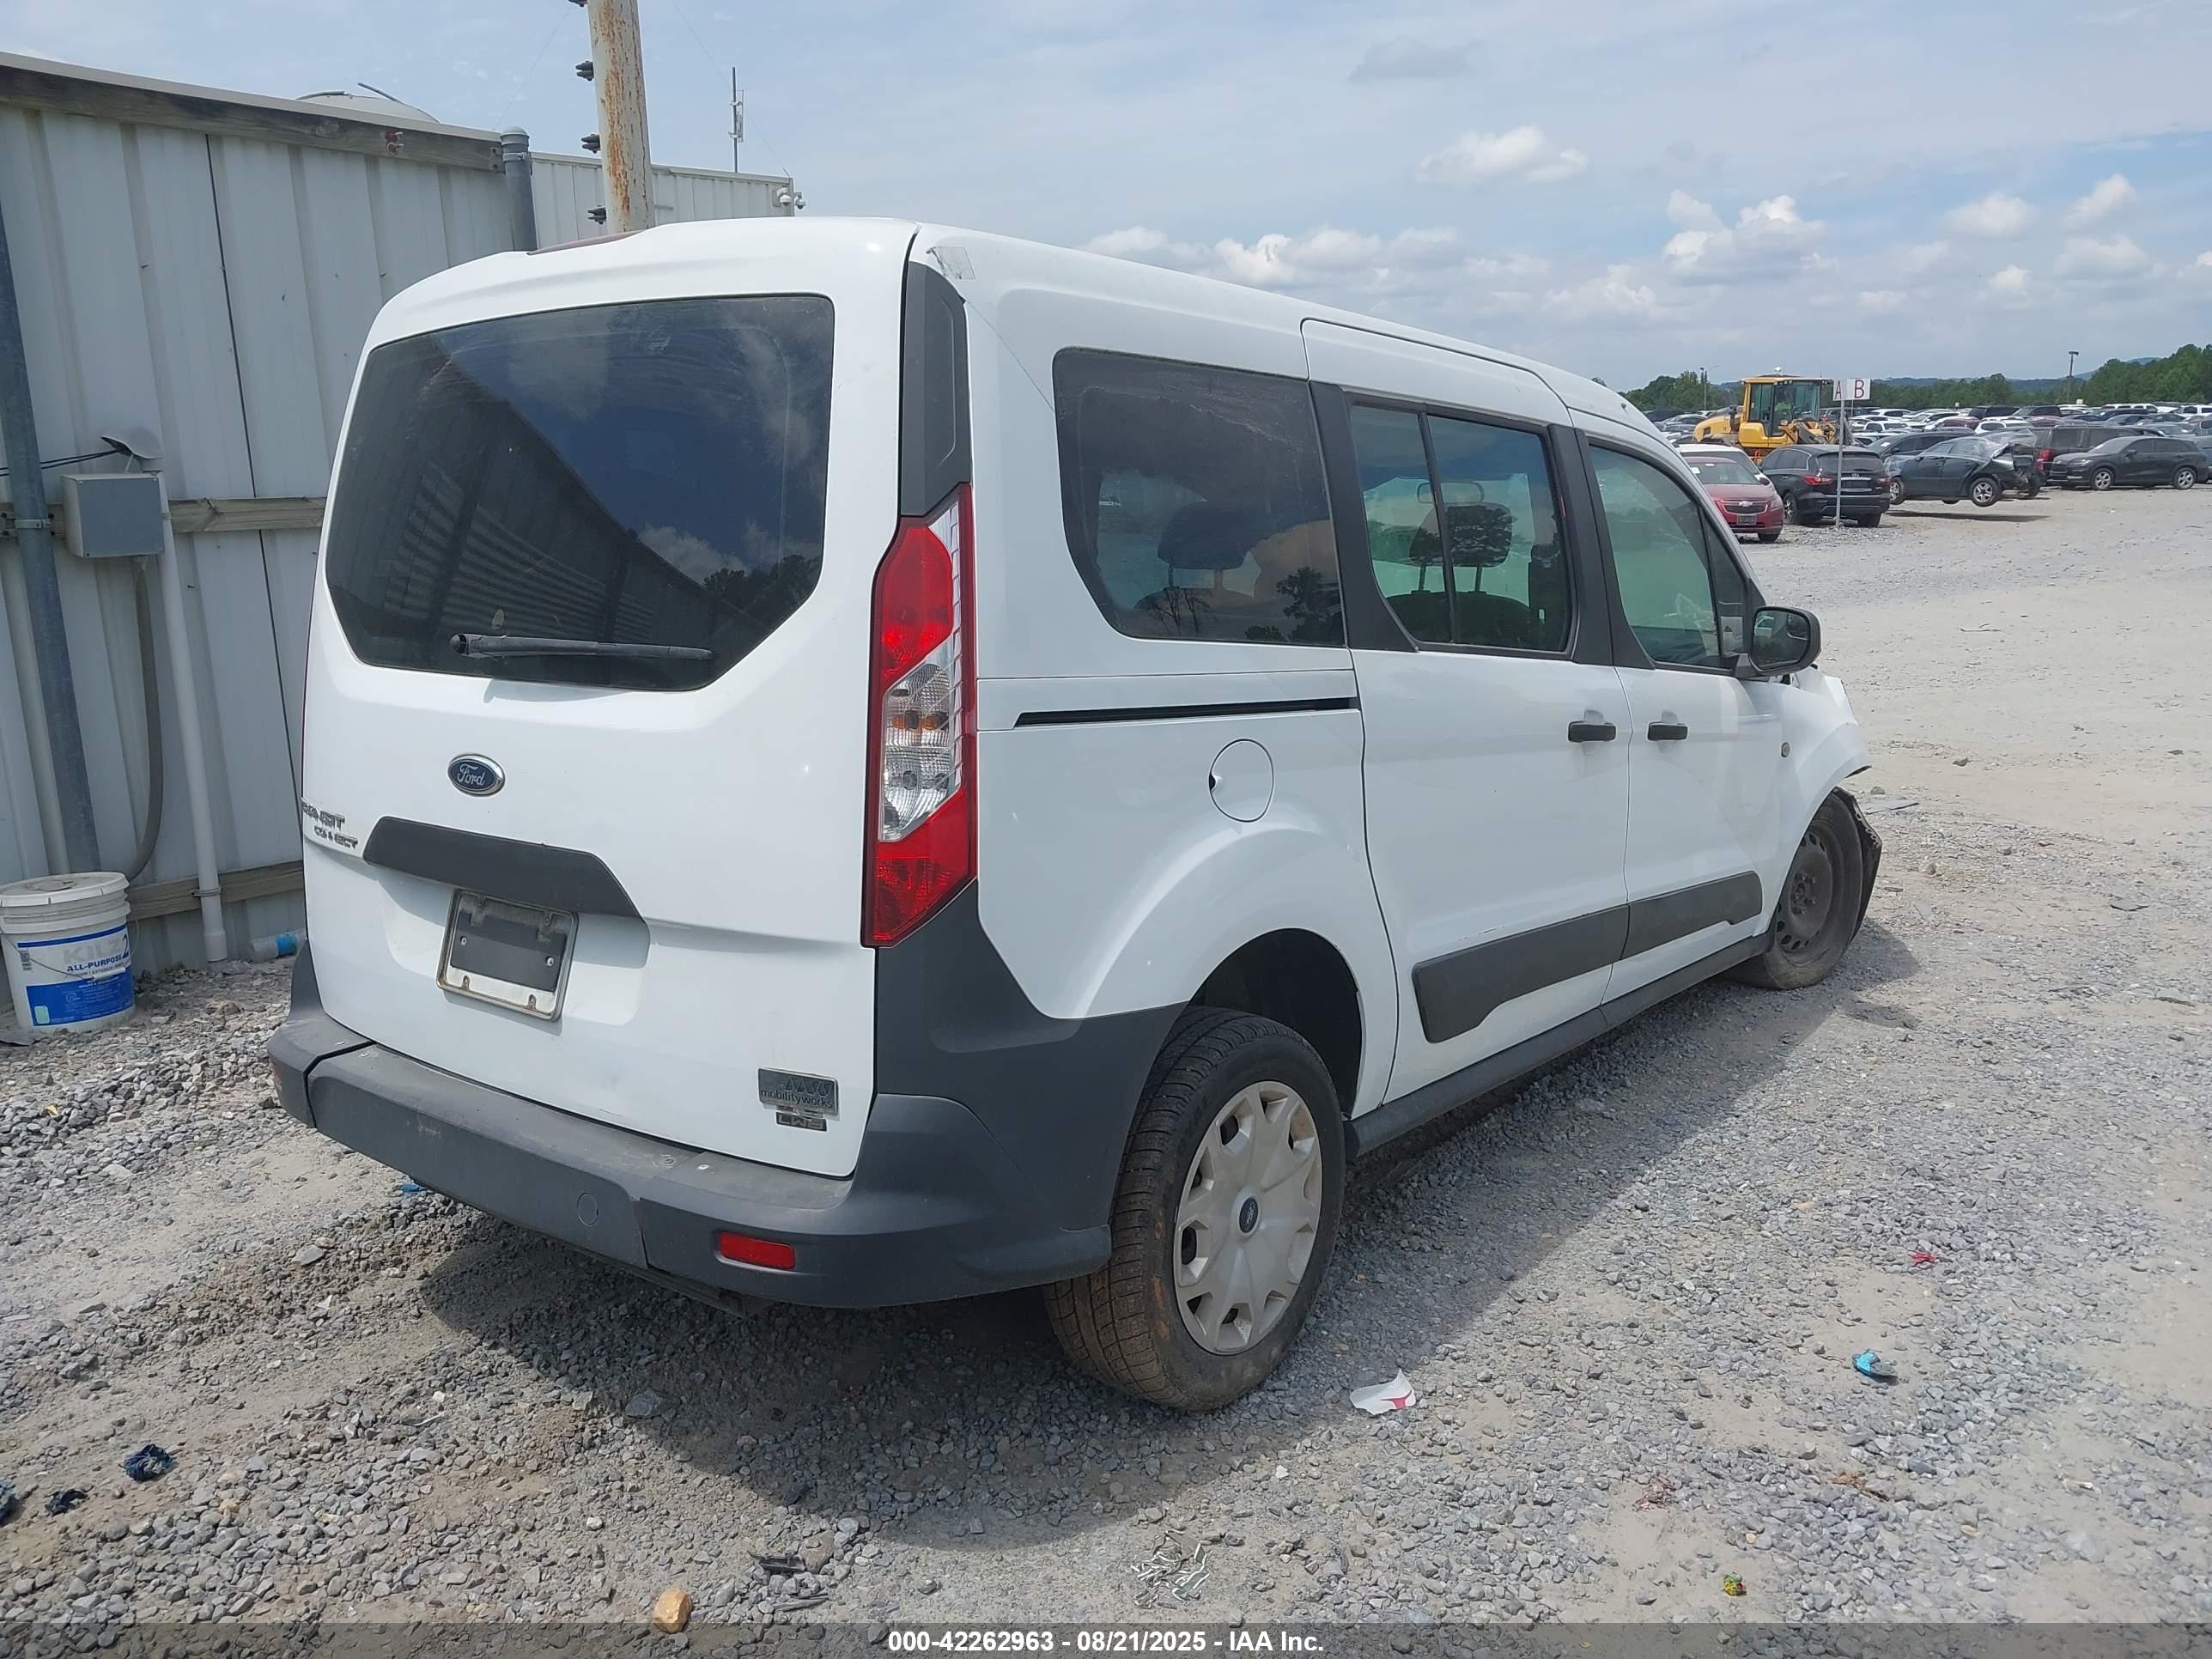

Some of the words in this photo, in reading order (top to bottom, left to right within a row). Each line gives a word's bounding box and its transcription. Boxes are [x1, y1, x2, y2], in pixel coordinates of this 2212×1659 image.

[1834, 380, 1842, 399] A
[1854, 380, 1864, 398] B
[457, 763, 485, 786] Ford
[122, 933, 129, 959] 2
[761, 1089, 833, 1108] mobilityworks
